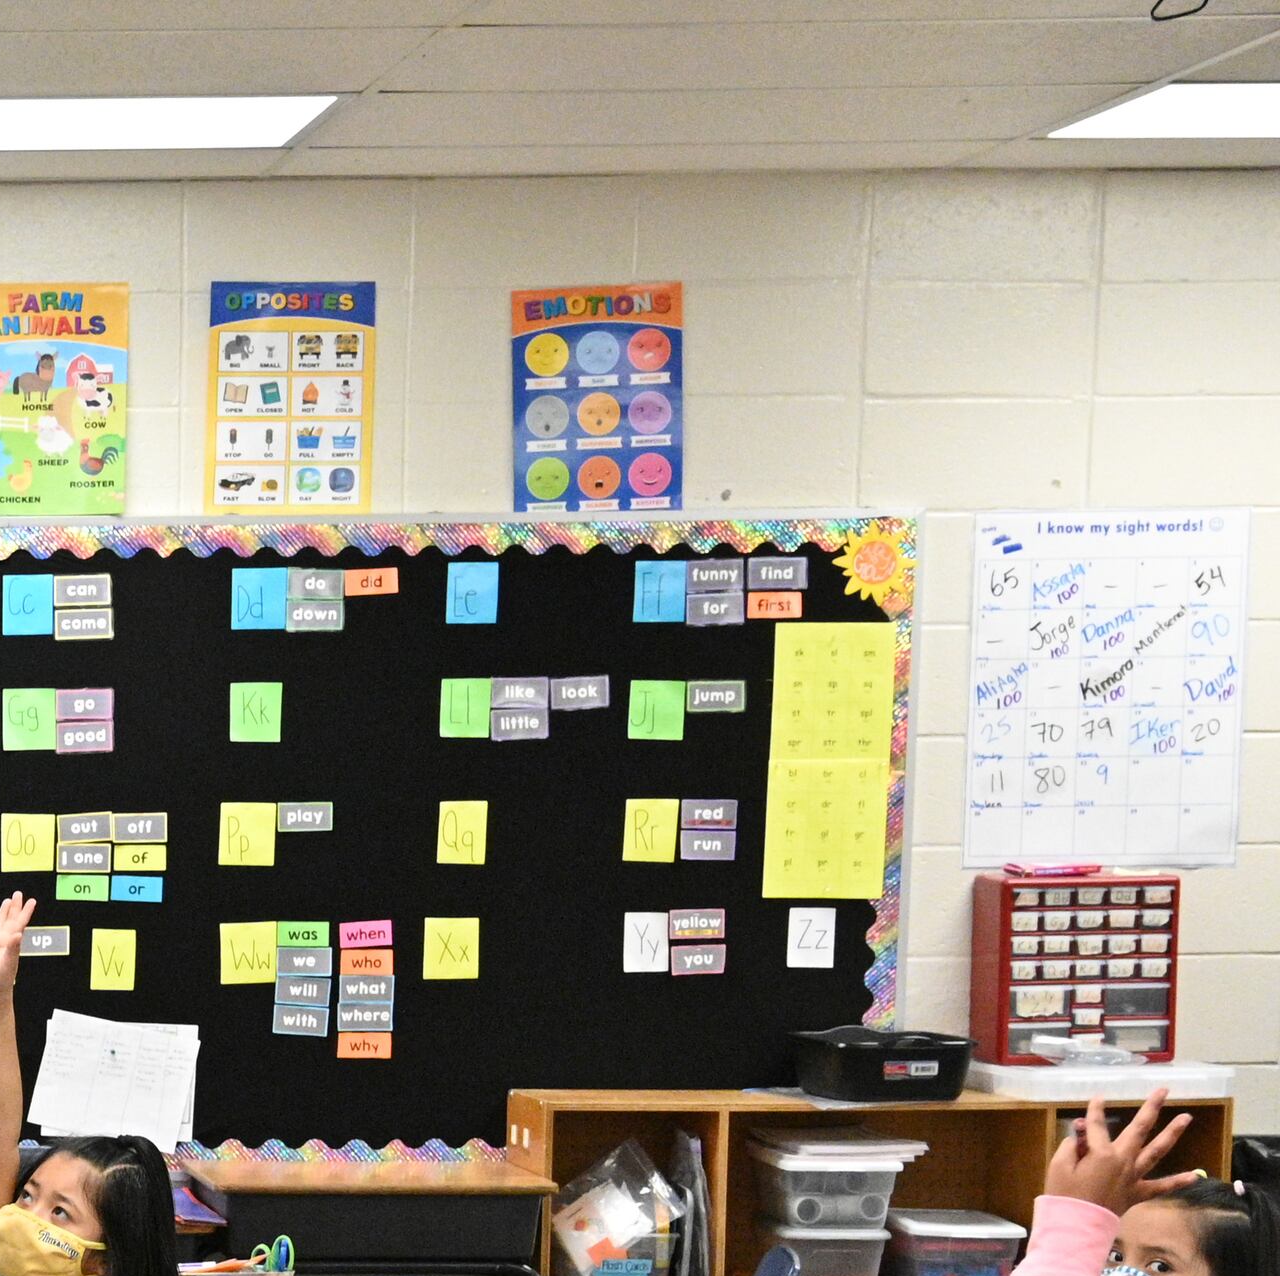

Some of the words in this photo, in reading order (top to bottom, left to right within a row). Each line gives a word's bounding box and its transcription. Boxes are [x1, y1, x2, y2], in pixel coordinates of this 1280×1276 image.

[8, 292, 83, 313] FARM
[225, 292, 355, 311] OPPOSITES
[524, 293, 672, 321] EMOTIONS
[1037, 522, 1041, 535] I
[1047, 522, 1084, 533] know
[1090, 523, 1110, 536] my
[1116, 520, 1150, 535] sight
[1156, 519, 1203, 533] words!
[692, 568, 738, 583] funny
[761, 566, 794, 580] find
[360, 576, 382, 588] did
[990, 568, 1019, 597] 65
[1194, 566, 1226, 596] 54
[67, 584, 97, 597] can
[292, 608, 338, 621] down
[703, 602, 728, 614] for
[61, 618, 106, 630] come
[1030, 615, 1075, 652] Jorge
[1184, 656, 1238, 702] David
[505, 685, 535, 698] like
[562, 686, 597, 699] look
[694, 688, 736, 704] jump
[500, 716, 539, 730] little
[1082, 718, 1114, 739] 79
[1190, 718, 1221, 742] 20
[64, 729, 106, 746] good
[1032, 722, 1064, 743] 70
[1035, 765, 1066, 794] 80
[287, 809, 323, 825] play
[694, 806, 723, 820] red
[71, 820, 98, 833] out
[128, 821, 152, 833] off
[694, 838, 721, 851] run
[673, 916, 721, 930] yellow
[32, 935, 52, 948] up
[288, 929, 318, 941] was
[346, 928, 386, 941] when
[352, 956, 382, 969] who
[684, 953, 713, 968] you
[346, 982, 386, 995] what
[283, 1015, 317, 1028] with
[341, 1010, 389, 1022] where
[350, 1040, 379, 1052] why
